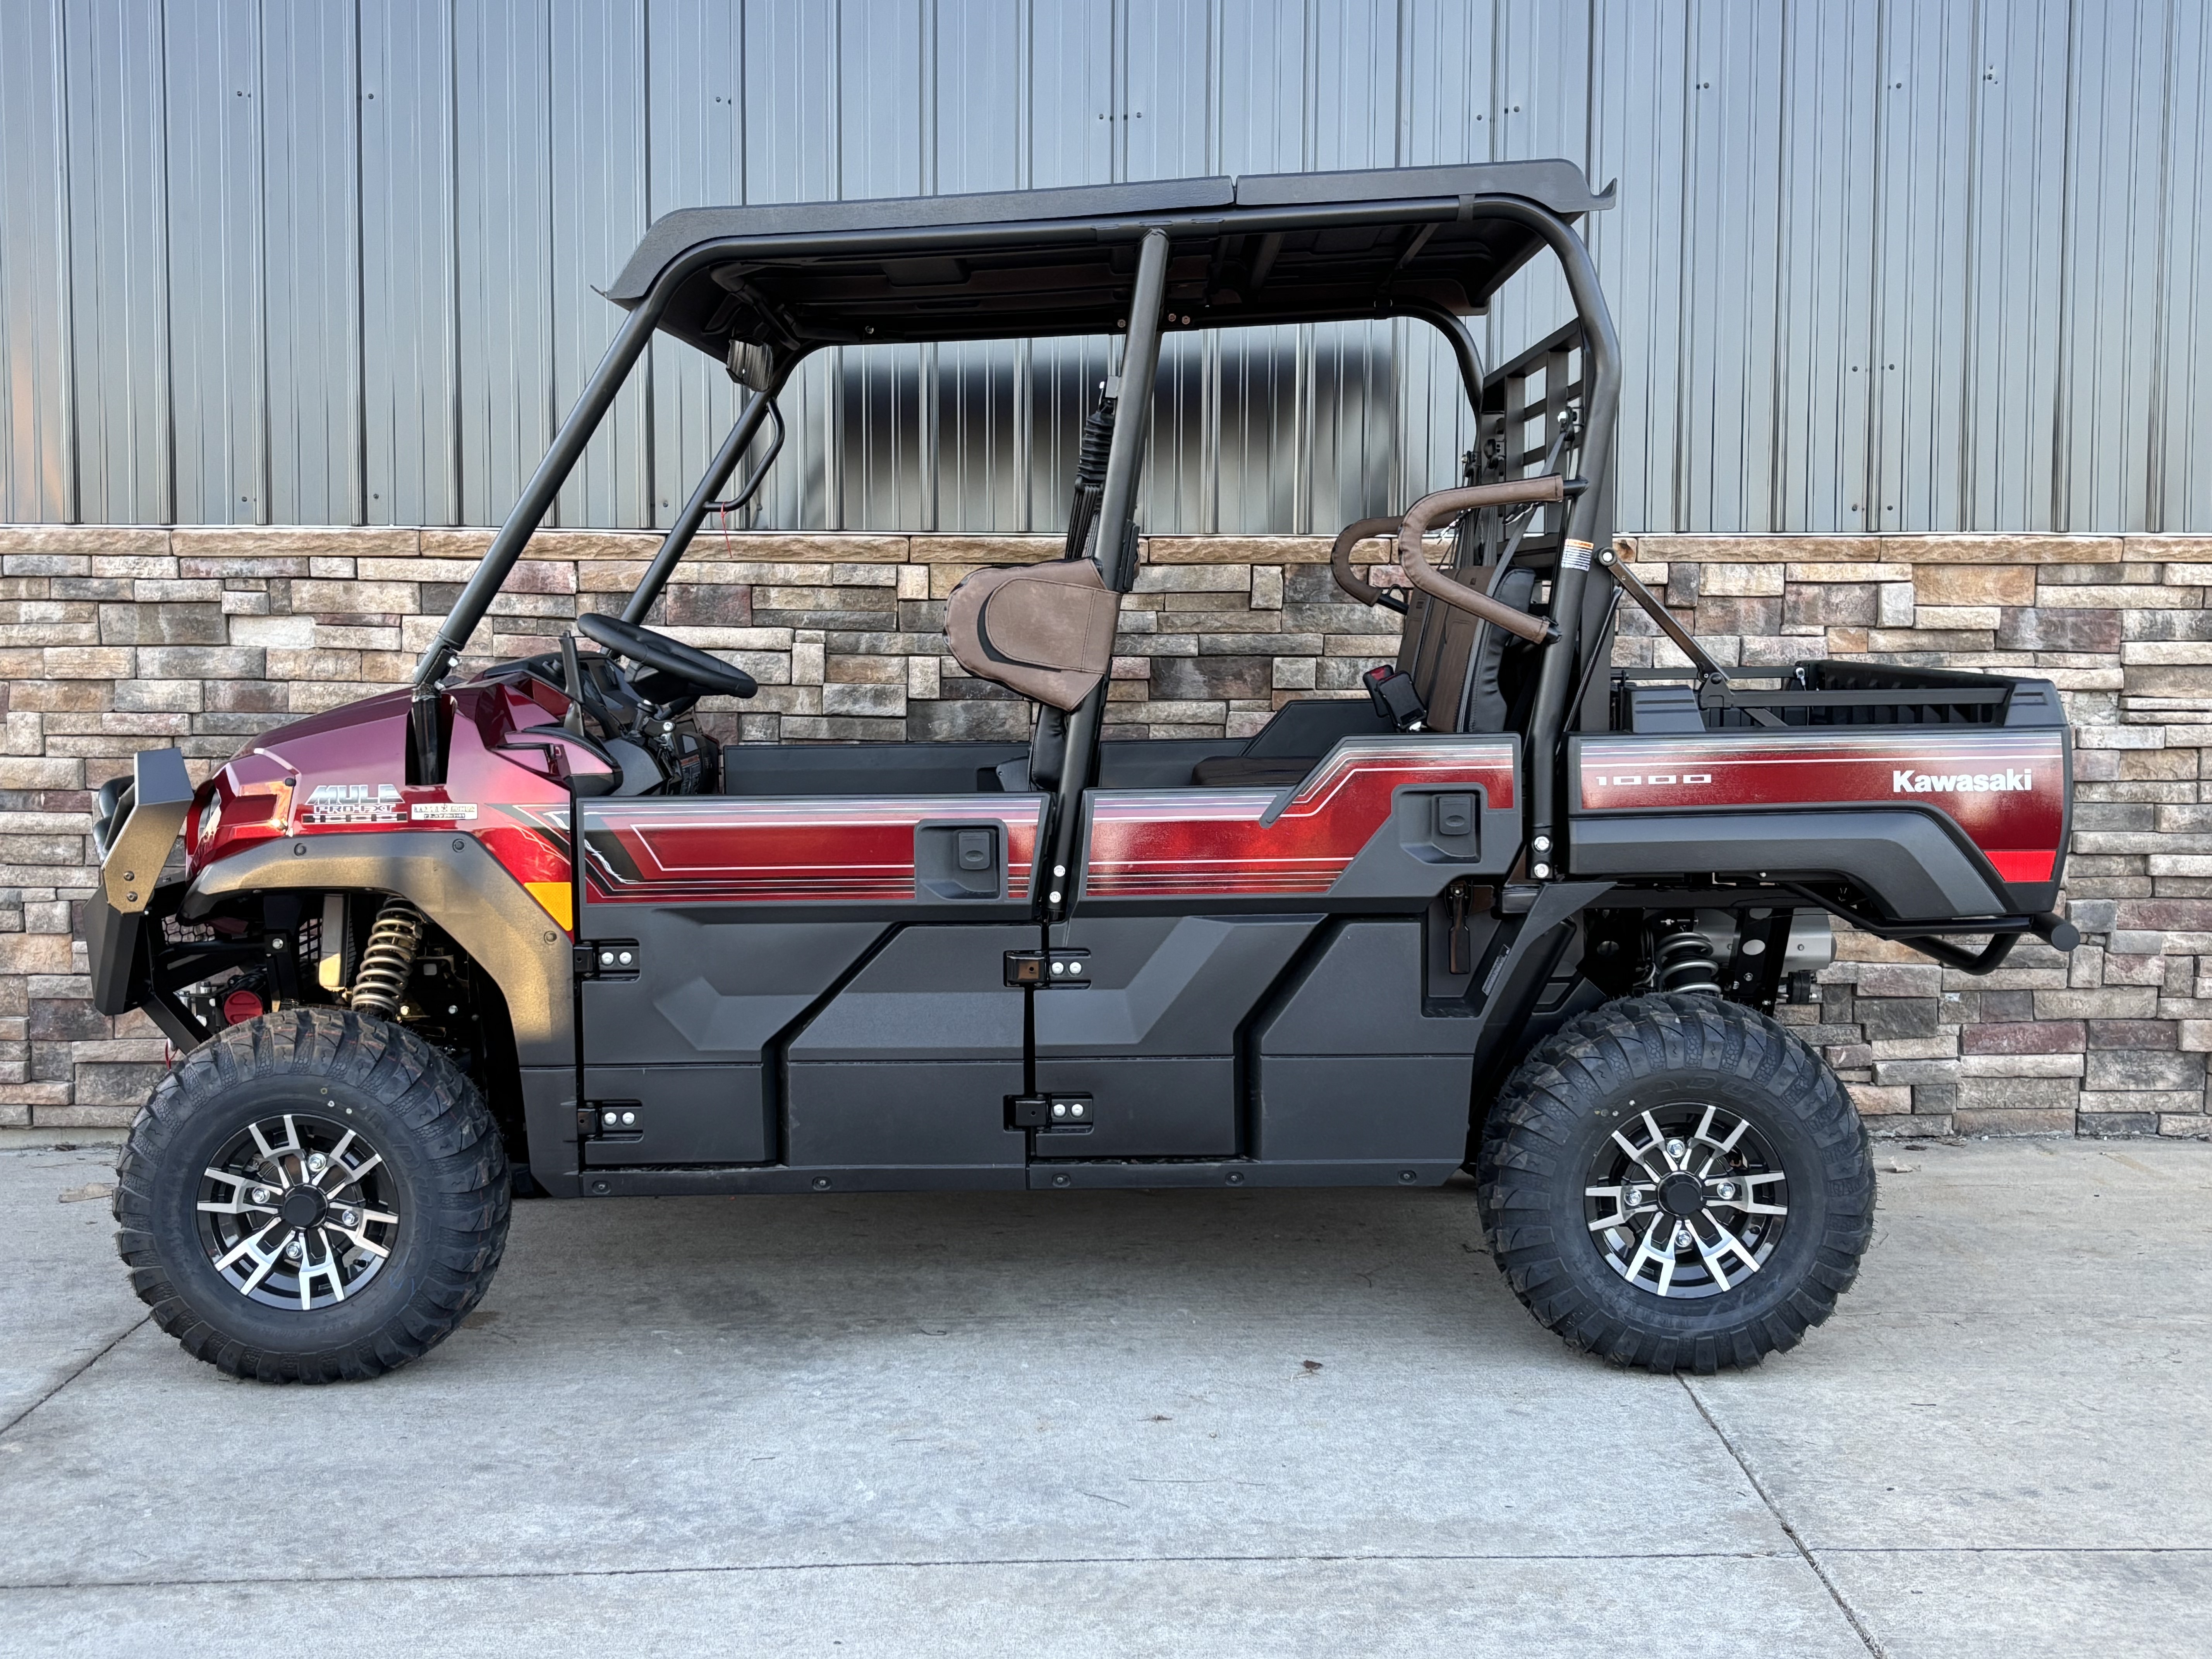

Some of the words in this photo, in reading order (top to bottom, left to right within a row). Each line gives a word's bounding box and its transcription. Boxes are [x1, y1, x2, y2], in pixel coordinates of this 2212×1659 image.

[1595, 774, 1712, 786] 1000
[1893, 768, 2032, 793] Kawasaki
[304, 784, 405, 805] MULE
